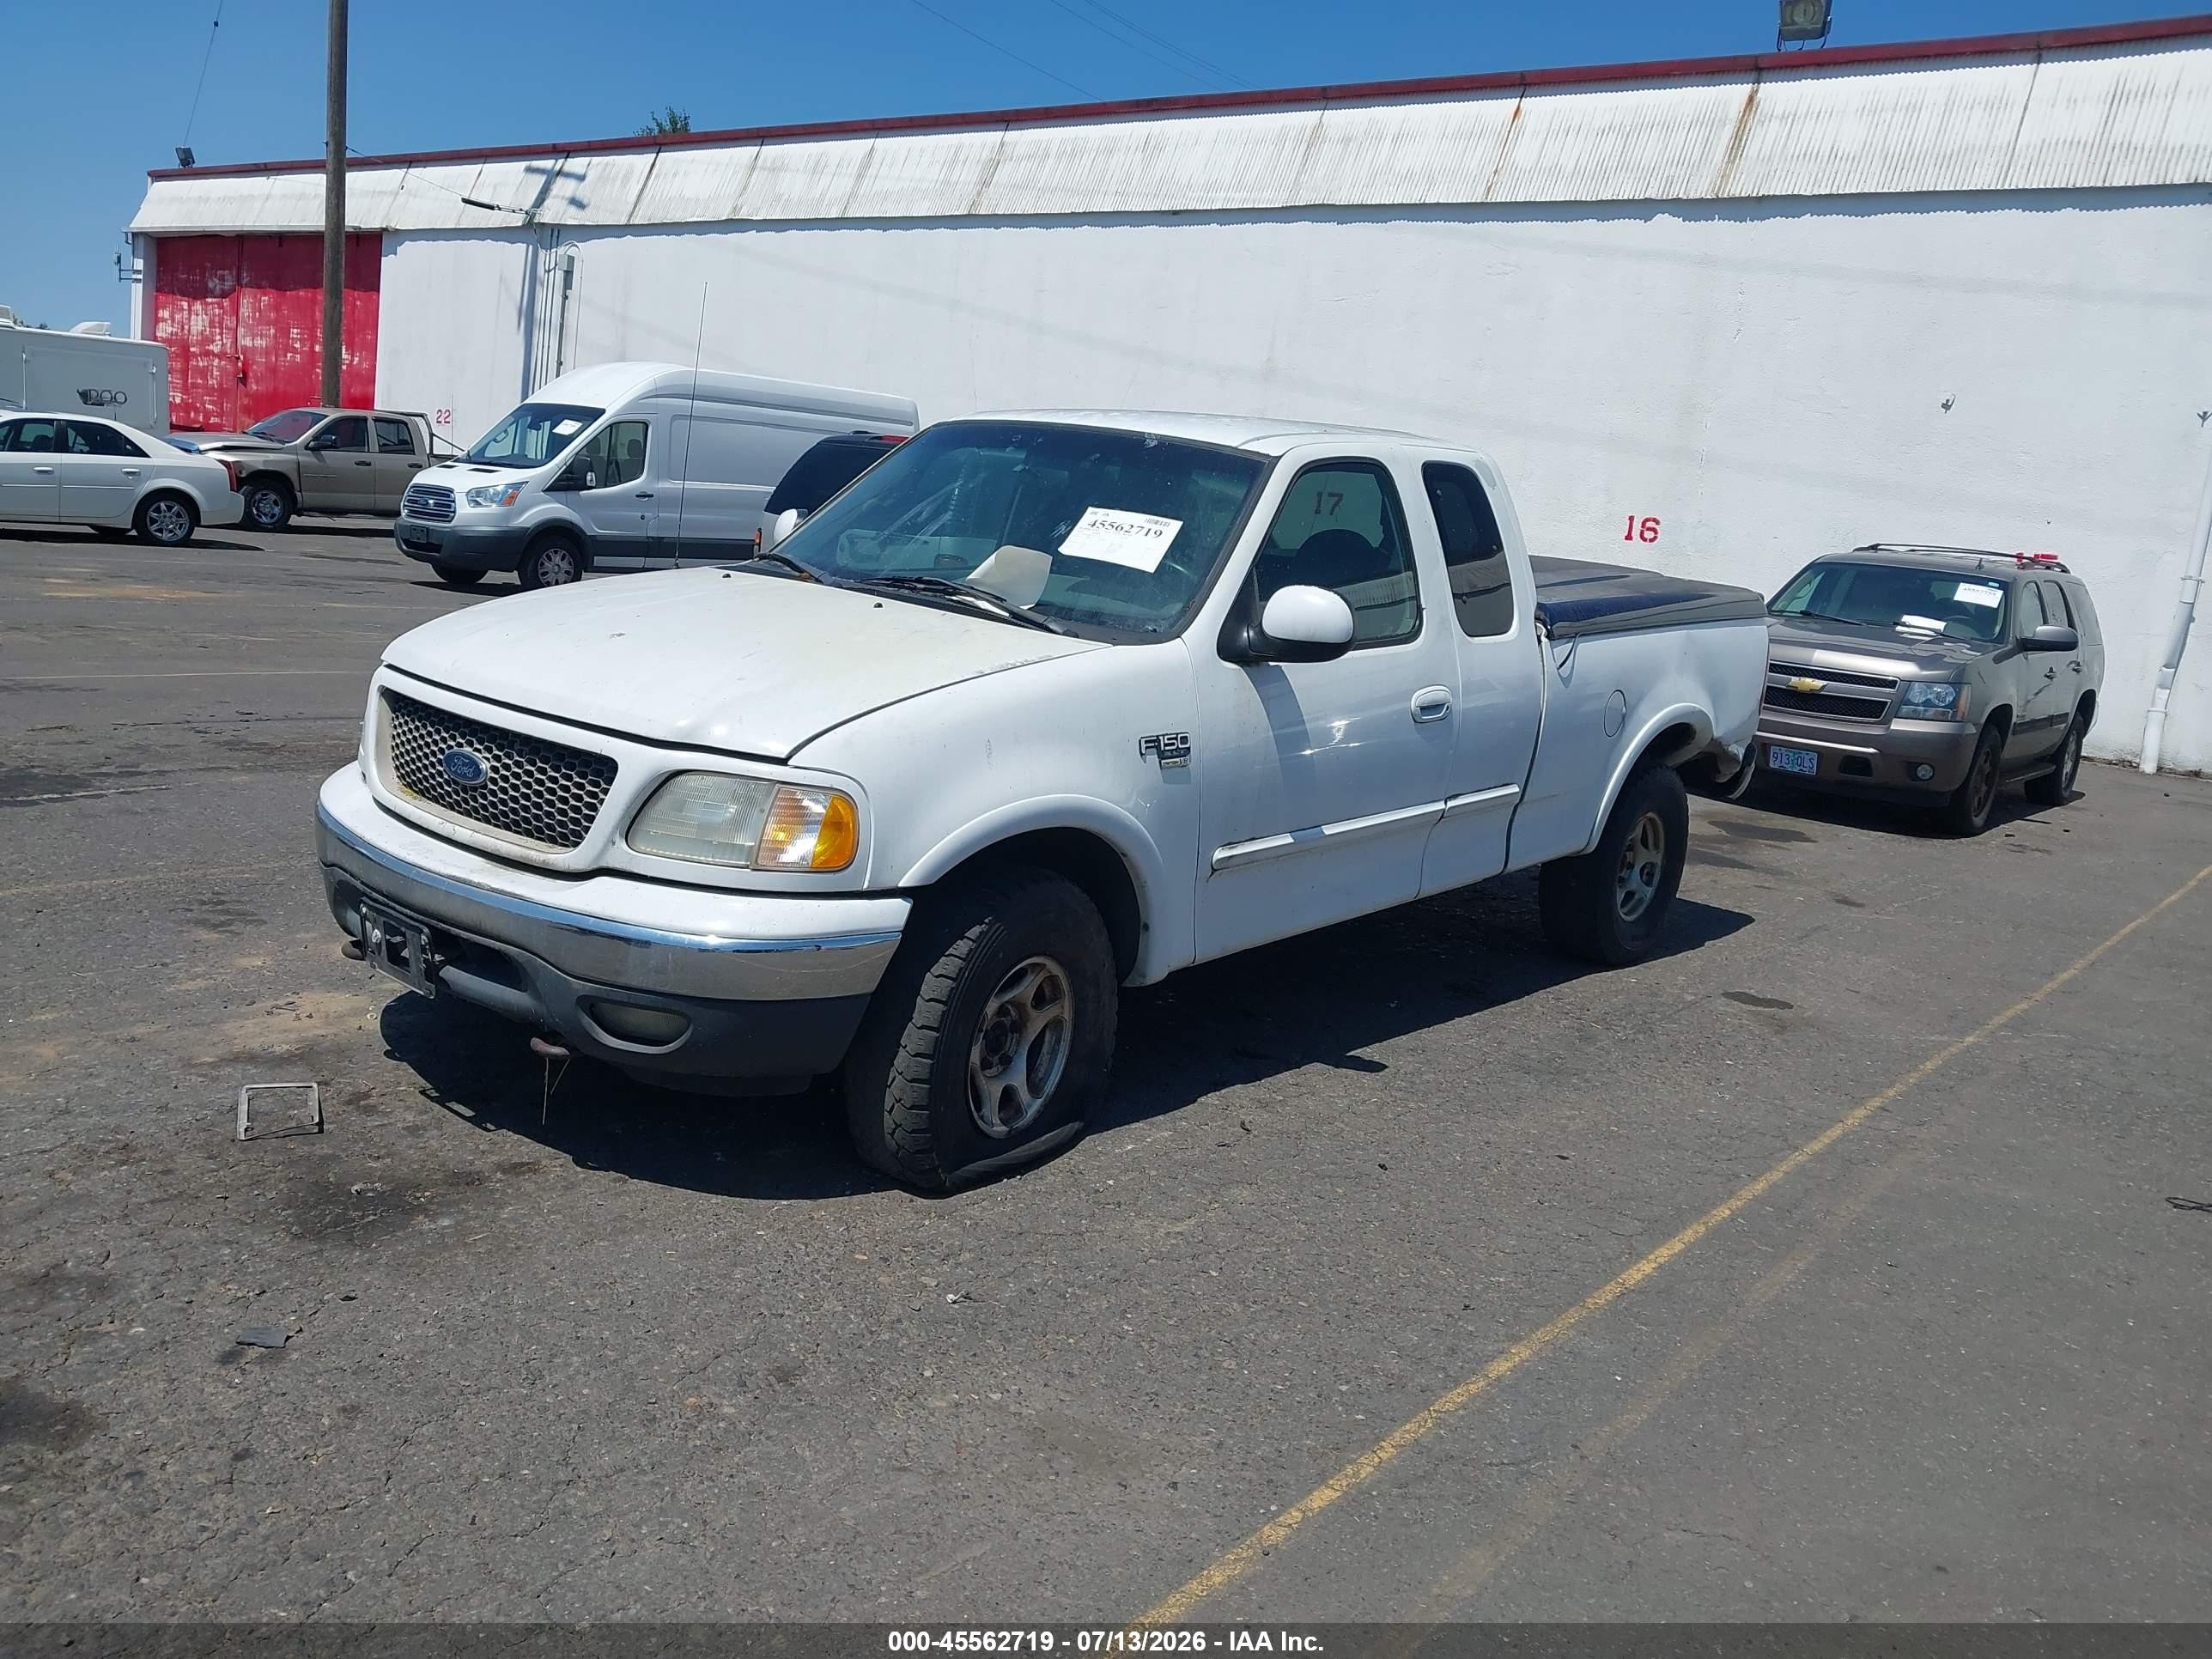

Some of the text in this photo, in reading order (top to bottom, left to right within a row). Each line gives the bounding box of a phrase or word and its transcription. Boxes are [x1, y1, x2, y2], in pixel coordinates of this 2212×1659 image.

[435, 409, 451, 423] 22
[1314, 491, 1344, 516] 17
[1086, 519, 1164, 538] 45562719
[1624, 514, 1661, 544] 16
[1140, 732, 1191, 754] F-150
[451, 755, 476, 777] Ford
[1772, 751, 1814, 769] 913 OLS
